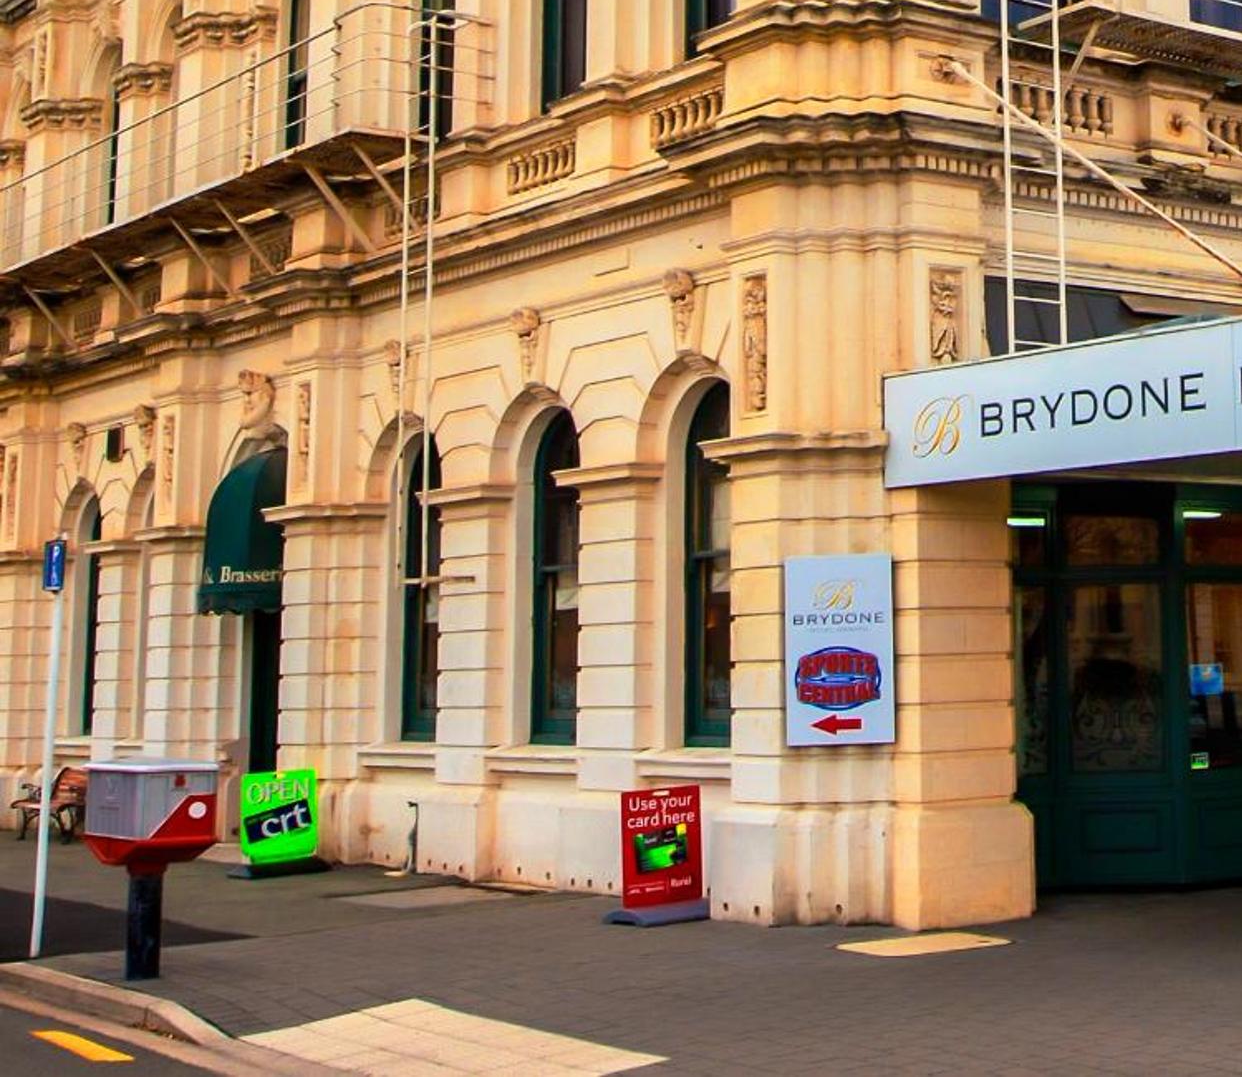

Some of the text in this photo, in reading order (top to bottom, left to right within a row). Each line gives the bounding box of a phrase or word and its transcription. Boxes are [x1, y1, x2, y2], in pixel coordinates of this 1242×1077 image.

[980, 372, 1207, 438] BRYDONE
[792, 611, 885, 627] BRYDONE
[799, 651, 877, 678] SPORTS
[796, 681, 882, 705] CENTRAL
[246, 777, 309, 805] OPEN
[628, 794, 692, 813] Use your
[262, 803, 310, 837] crt
[627, 810, 695, 829] card here
